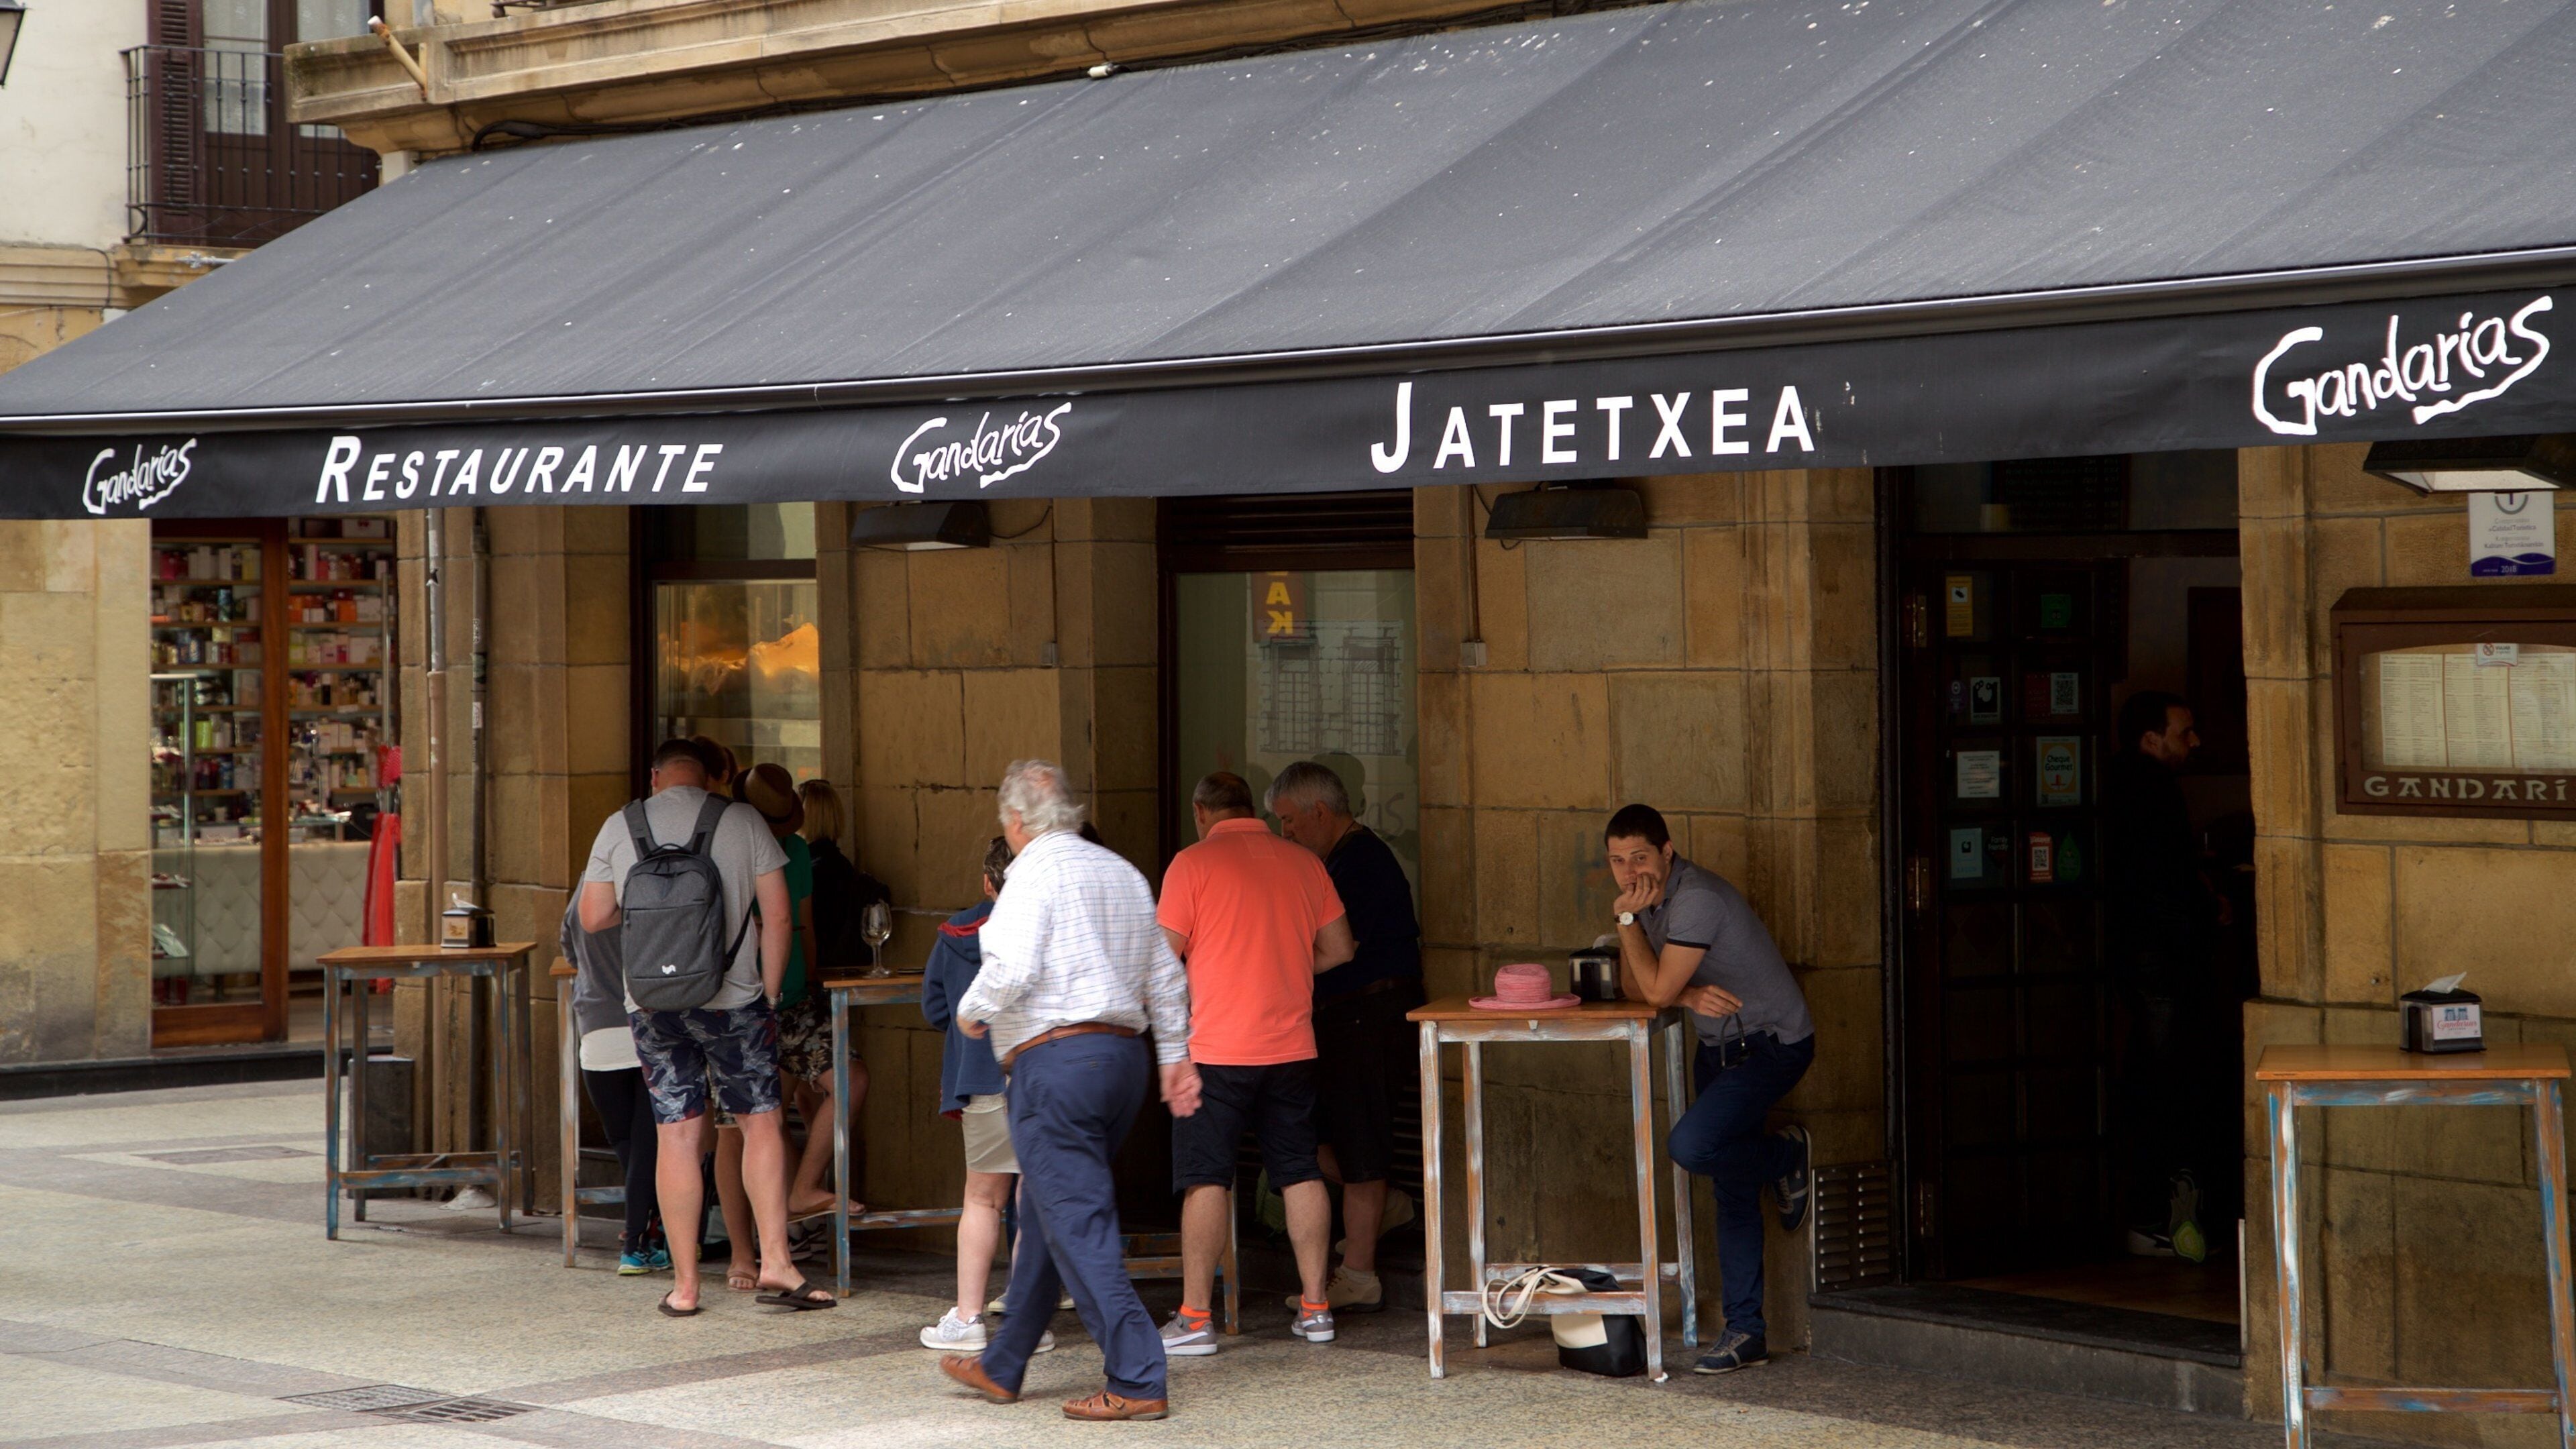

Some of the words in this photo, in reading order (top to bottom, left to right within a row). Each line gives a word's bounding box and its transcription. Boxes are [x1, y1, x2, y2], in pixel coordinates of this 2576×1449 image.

[2253, 295, 2553, 436] Gandarias
[315, 435, 724, 504] RESTAURANTE
[890, 402, 1072, 494] Gandarias
[1371, 382, 1815, 474] JATETXEA
[82, 438, 197, 515] Gandarias
[2047, 755, 2071, 763] Cheque
